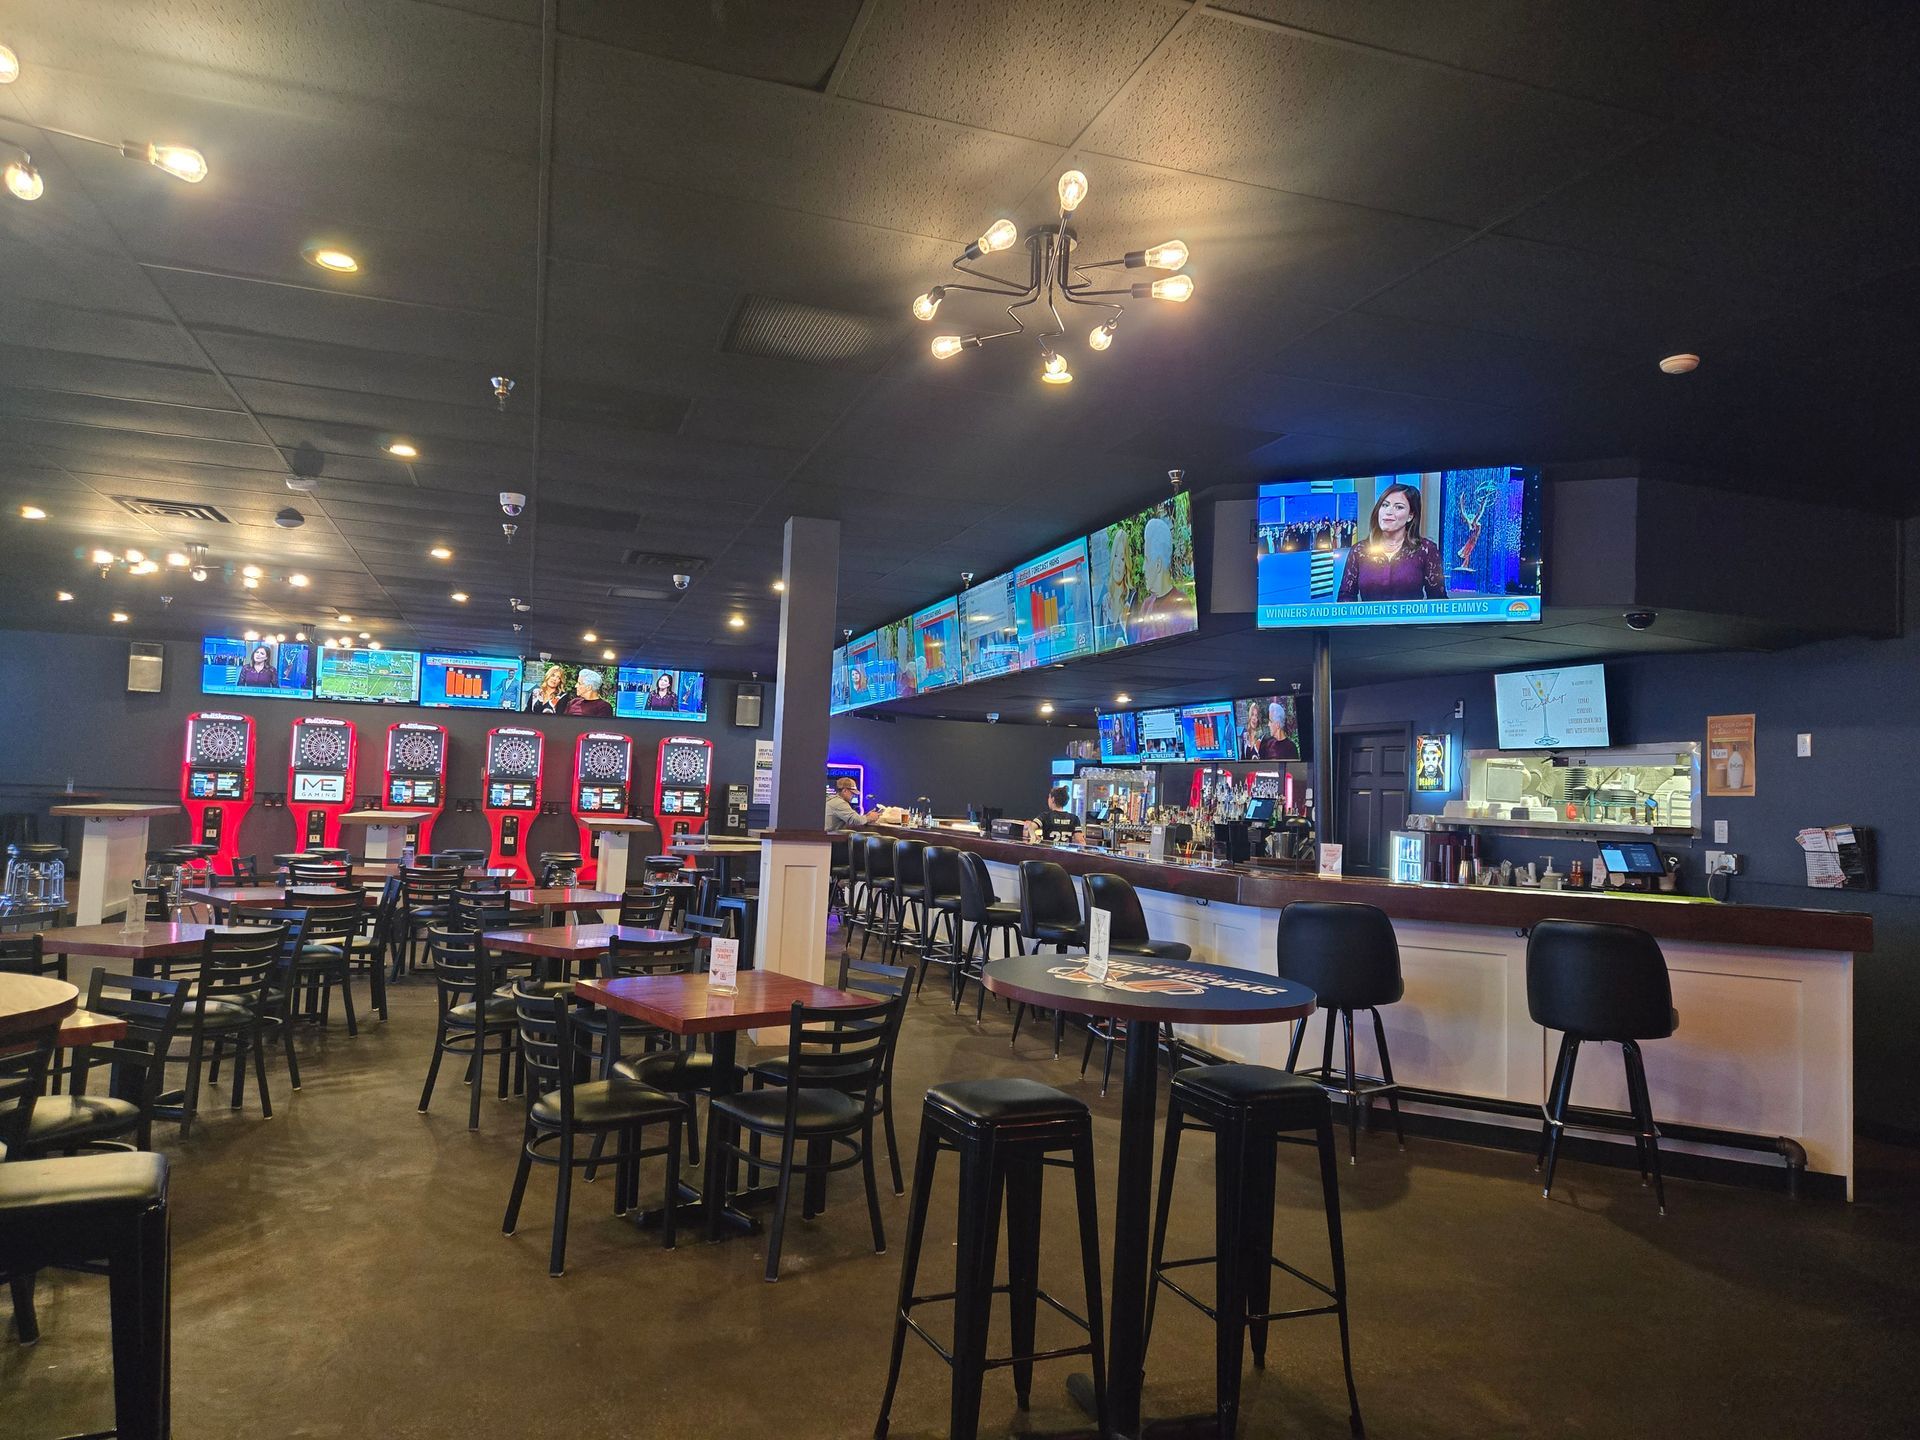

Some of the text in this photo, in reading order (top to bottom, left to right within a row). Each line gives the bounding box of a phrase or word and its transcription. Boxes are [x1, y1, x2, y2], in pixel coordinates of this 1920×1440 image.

[1266, 602, 1489, 618] WINNERS AND BIG MOMENTS FROM THE EMMYS
[303, 778, 337, 792] ME
[1065, 957, 1289, 995] SMASH HOUE
